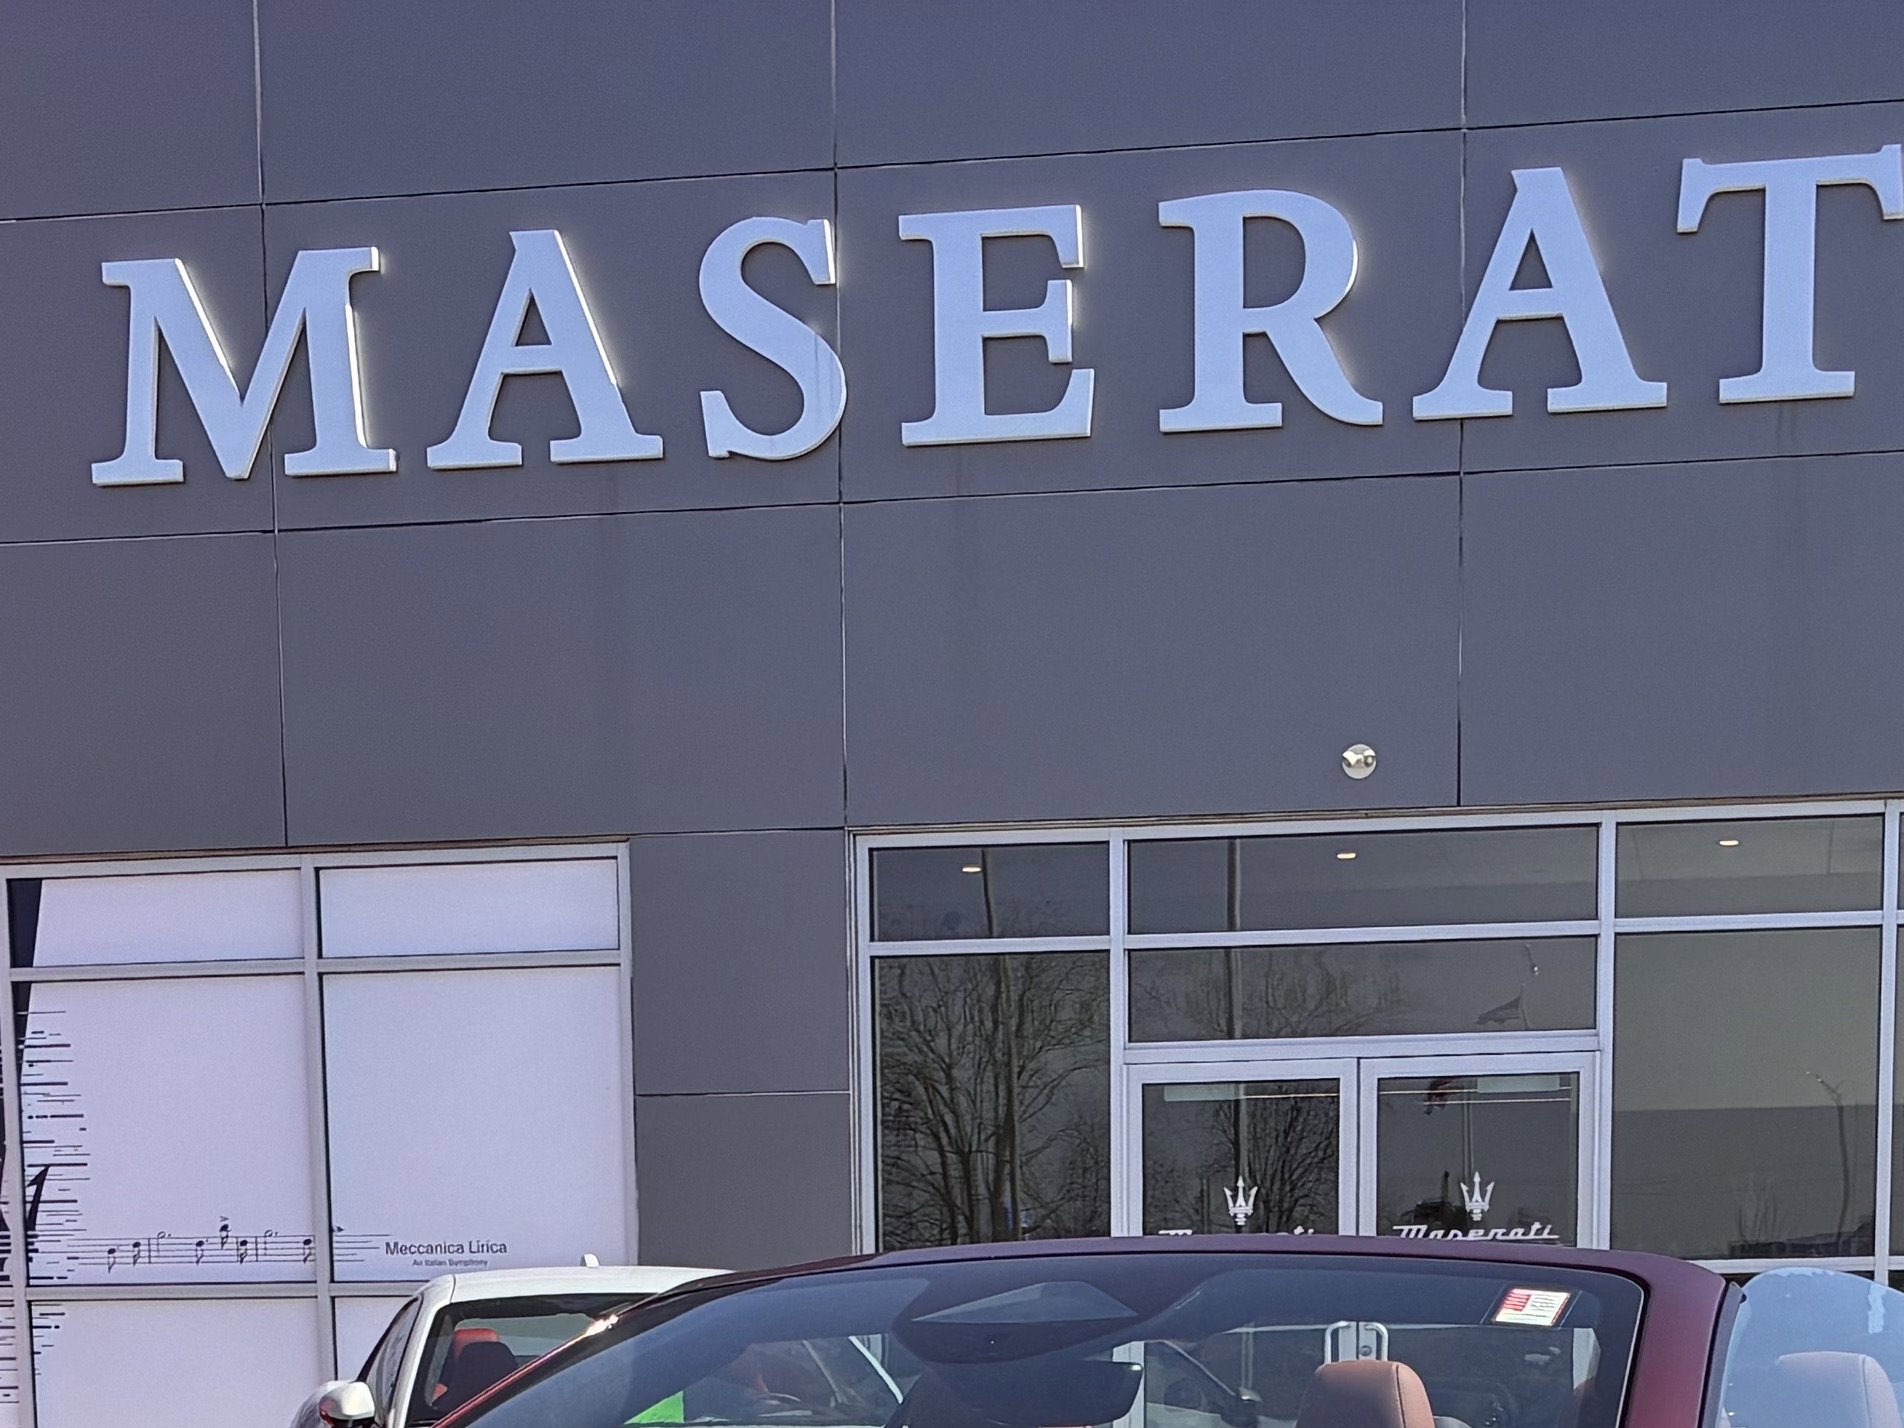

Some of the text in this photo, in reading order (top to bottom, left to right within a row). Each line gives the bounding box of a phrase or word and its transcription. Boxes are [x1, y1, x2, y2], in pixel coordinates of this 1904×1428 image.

[1392, 1221, 1560, 1241] Maserati
[385, 1240, 508, 1256] Meccanica Lirica
